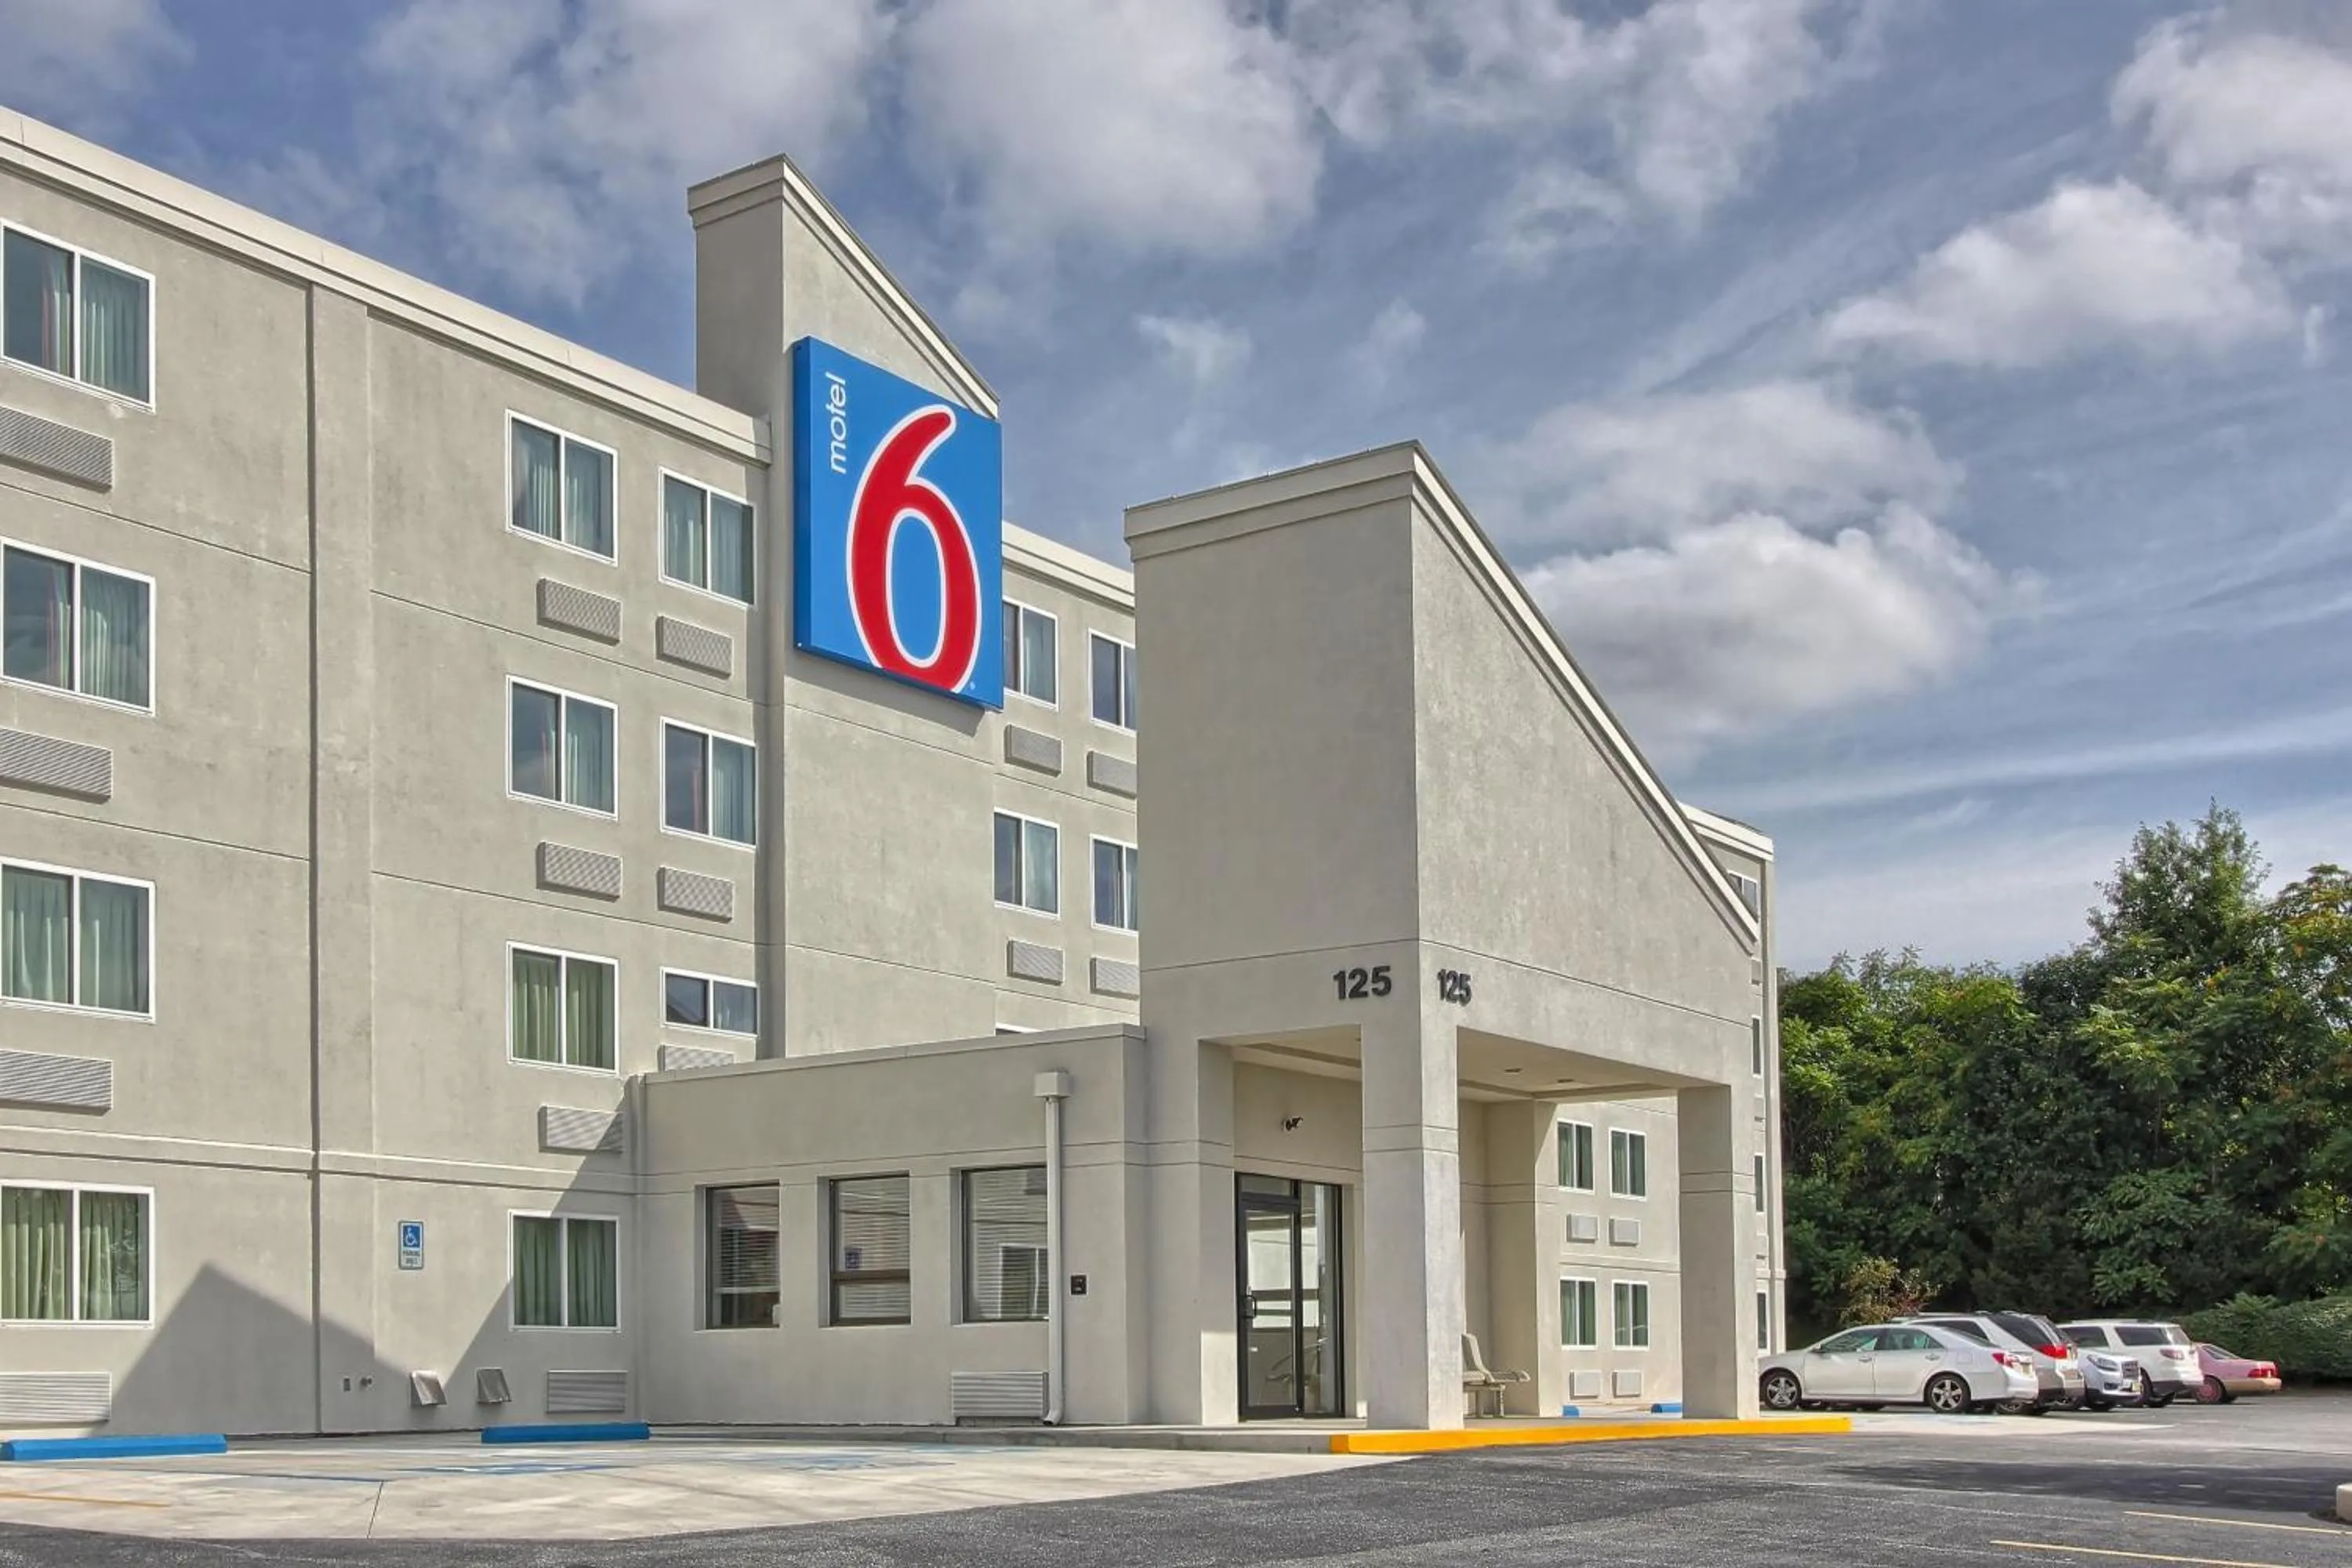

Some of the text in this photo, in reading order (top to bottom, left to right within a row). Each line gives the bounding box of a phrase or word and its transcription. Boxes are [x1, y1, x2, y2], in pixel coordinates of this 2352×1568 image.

[826, 372, 847, 474] motel
[847, 404, 982, 693] 6
[1333, 965, 1392, 1000] 125
[1437, 968, 1472, 1007] 125
